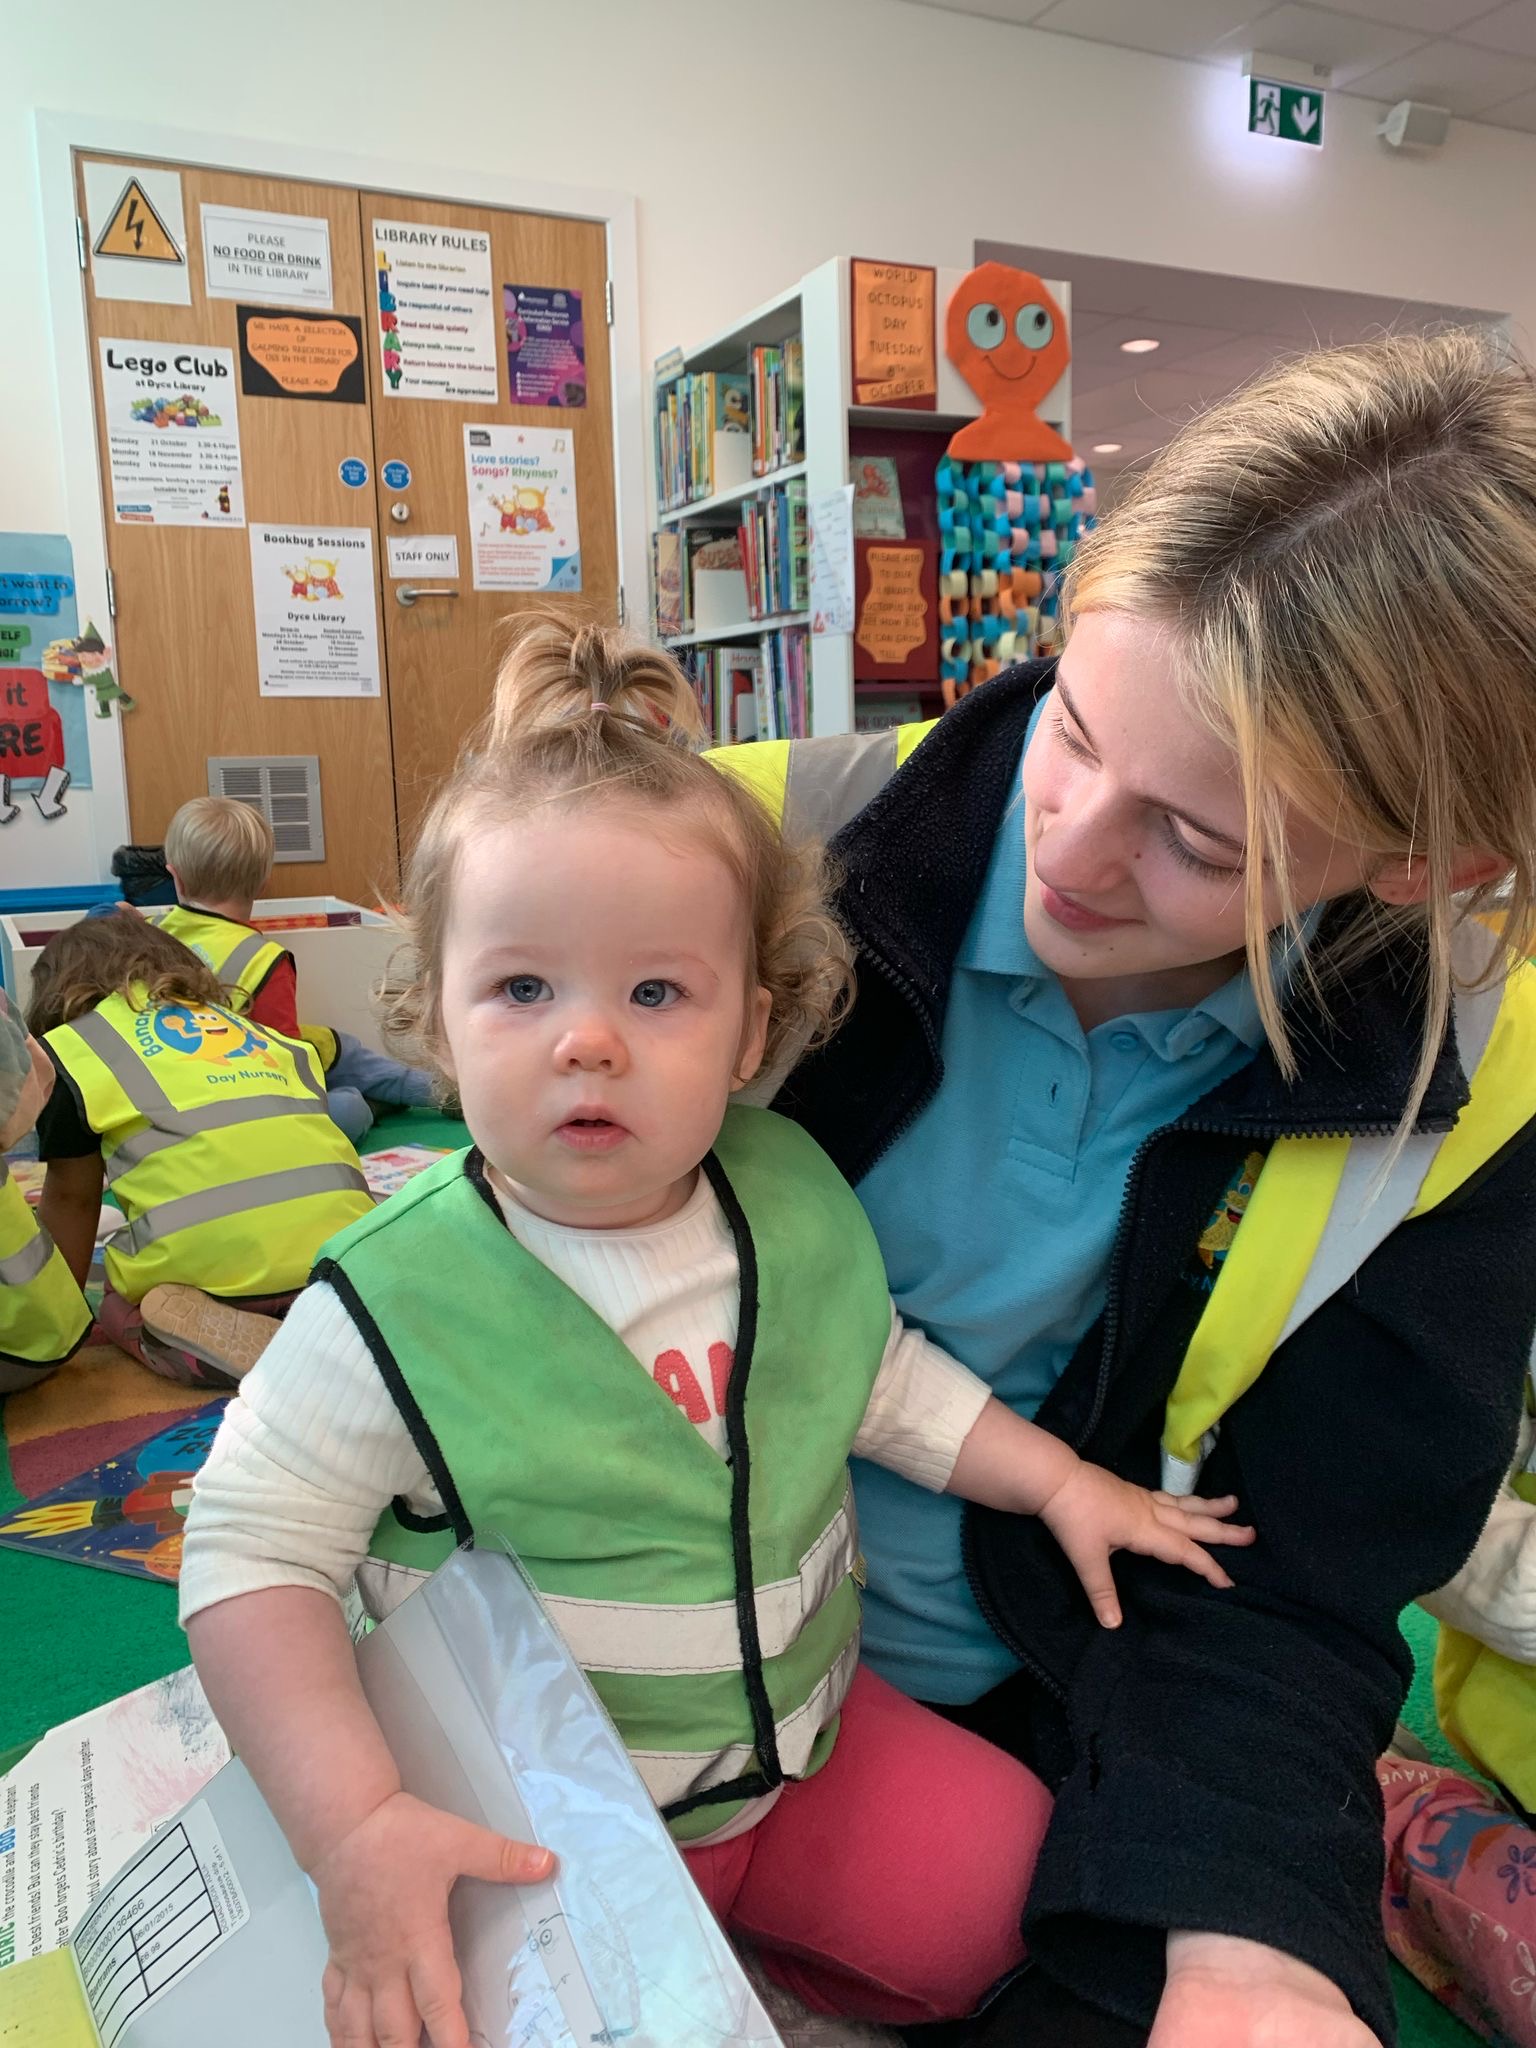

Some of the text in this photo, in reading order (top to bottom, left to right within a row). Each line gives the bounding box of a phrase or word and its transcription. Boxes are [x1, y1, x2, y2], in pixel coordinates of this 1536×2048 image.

[248, 232, 285, 247] PLEASE
[375, 228, 488, 252] LIBRARY RULES
[213, 245, 321, 266] NO FOOD OR DRINK
[228, 263, 309, 280] IN THE LIBRARY
[872, 267, 918, 284] WORLD
[867, 292, 923, 310] OCTOPUS
[269, 323, 290, 332] HAVE
[304, 325, 346, 336] SELECTION
[883, 316, 908, 331] DAY
[869, 339, 923, 357] TUESDAY
[106, 348, 228, 377] Lego Club
[147, 379, 172, 389] Dyce
[173, 380, 206, 392] Library
[869, 378, 925, 399] OCTOBER
[471, 453, 540, 466] Love stories?
[472, 466, 558, 480] Songs? Rhymes?
[263, 532, 366, 549] Bookbug Sessions
[395, 551, 450, 561] STAFF ONLY
[12, 578, 50, 590] want
[54, 579, 68, 590] to
[287, 612, 346, 624] Dyce Library
[6, 682, 27, 707] it
[0, 722, 45, 758] RE
[206, 1069, 289, 1087] Day Nursery
[80, 1764, 95, 1782] days
[4, 1785, 18, 1815] elephant
[80, 1782, 96, 1807] special
[4, 1814, 16, 1828] the
[82, 1803, 97, 1836] sharing
[84, 1834, 99, 1859] about
[3, 1851, 15, 1867] and
[27, 1783, 43, 1957] re best friends! But can they stay best friends
[51, 1807, 71, 1948] after Boo forgets Cedric's birthday?
[87, 1857, 102, 1881] story
[1, 1866, 15, 1905] crocodile
[1, 1905, 15, 1921] the
[101, 1896, 116, 1914] CITY
[134, 1902, 175, 1941] 06/01/2015
[0, 1921, 15, 1968] EDRIC
